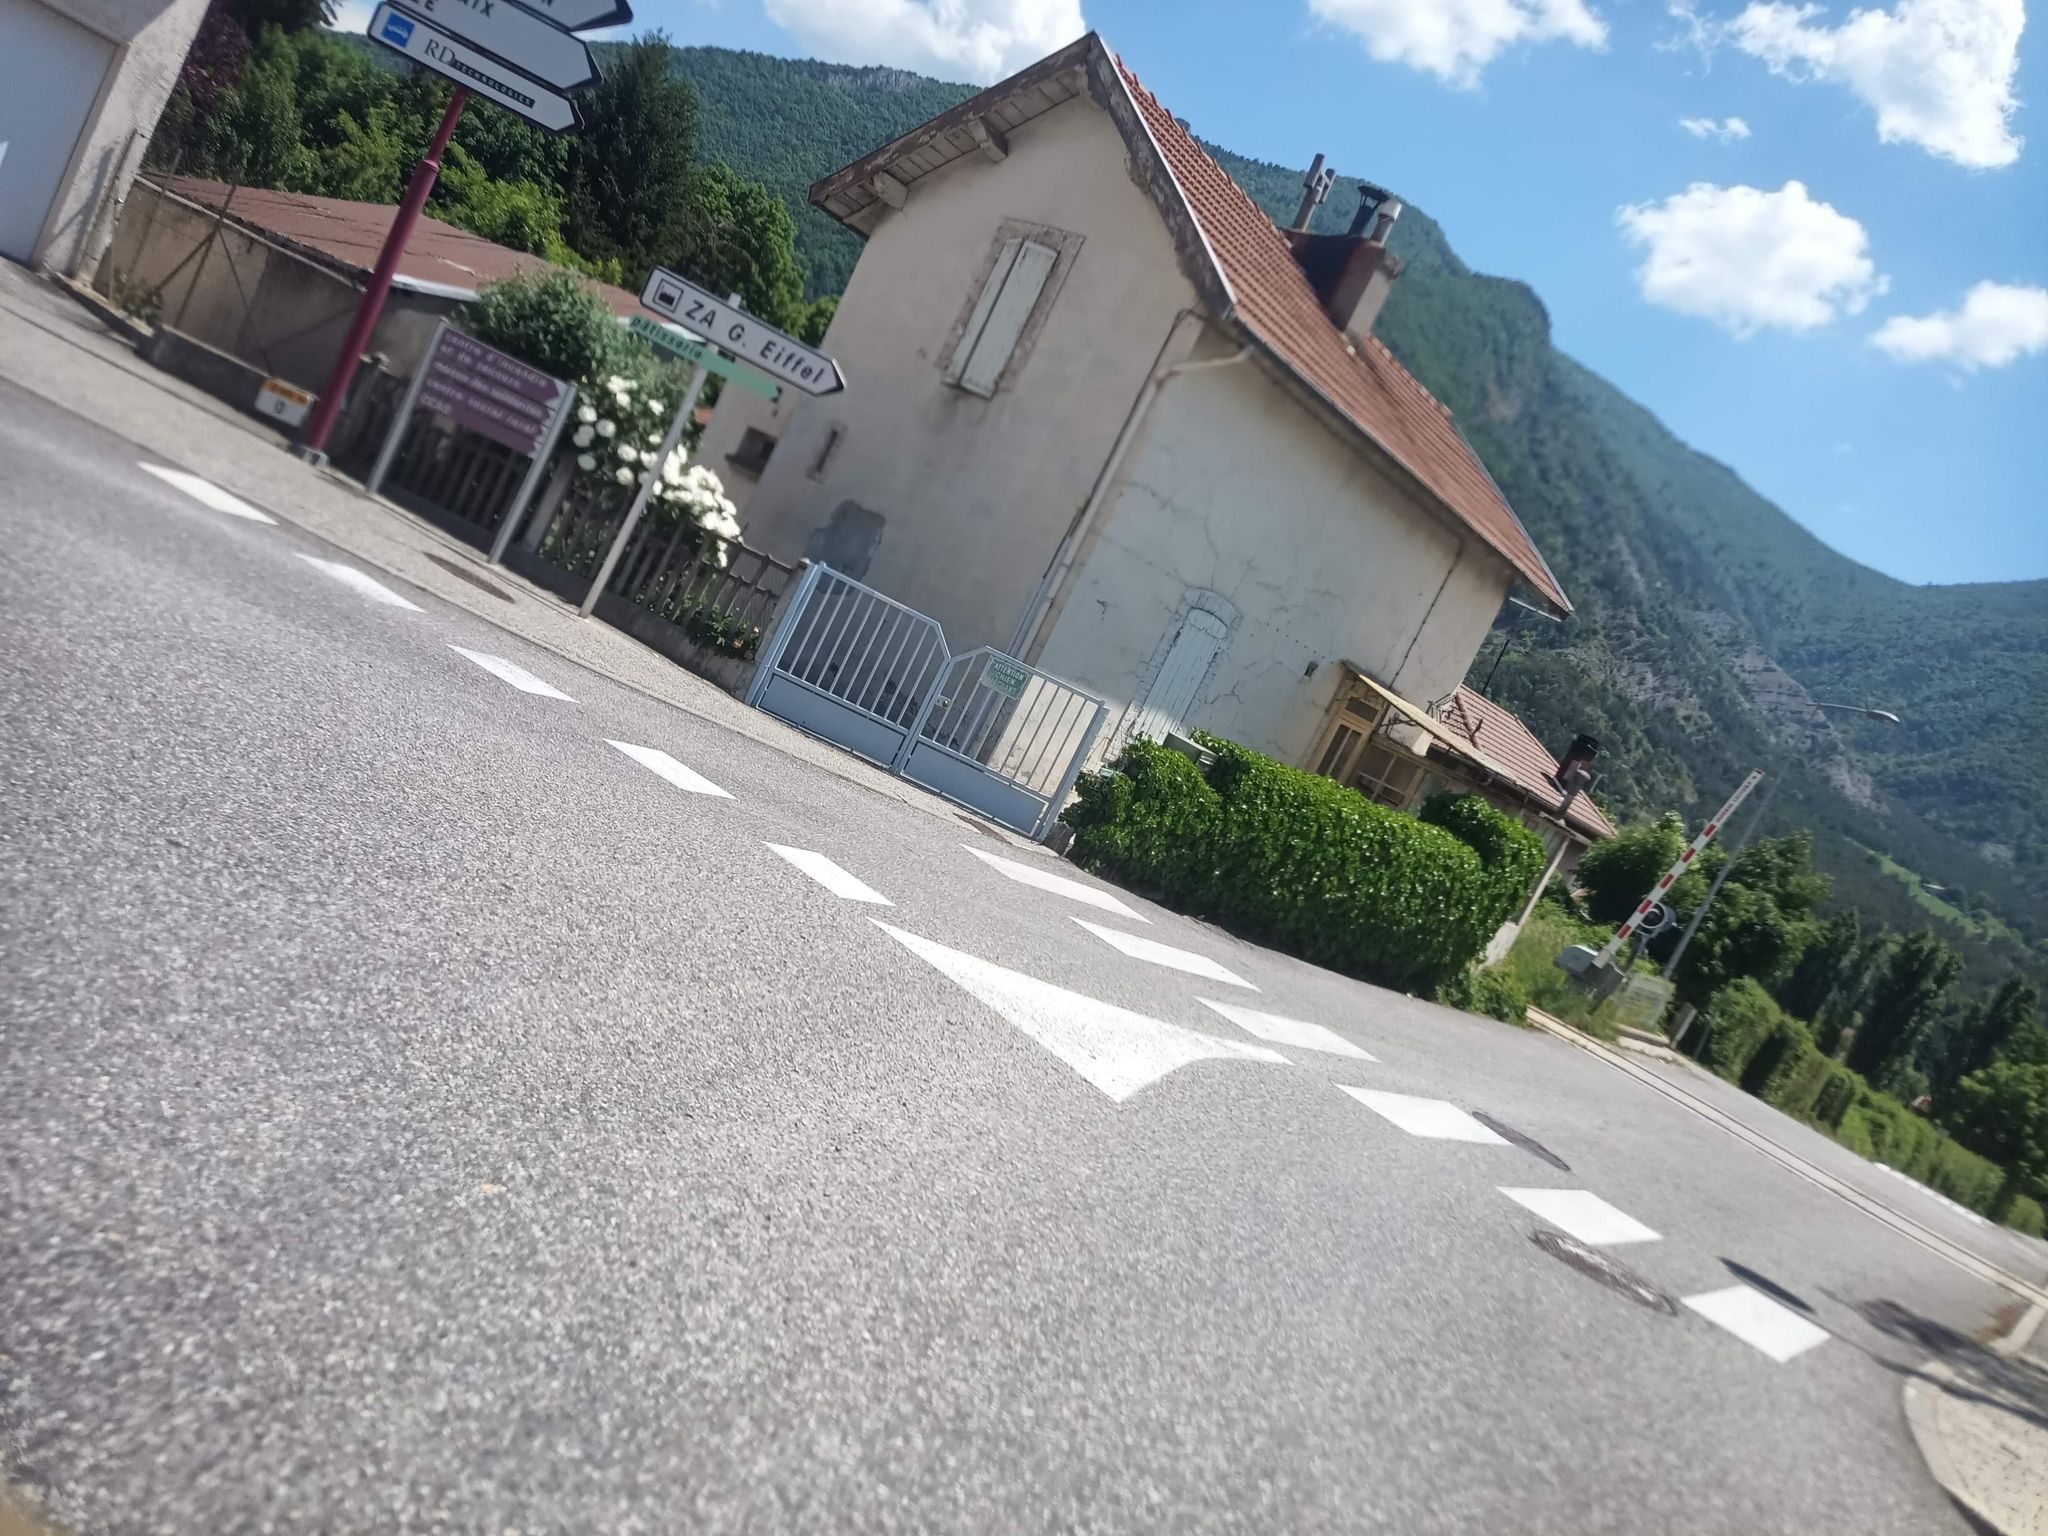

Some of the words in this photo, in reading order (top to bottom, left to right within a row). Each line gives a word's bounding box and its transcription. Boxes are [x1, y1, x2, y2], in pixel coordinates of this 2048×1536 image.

[455, 61, 534, 106] TECHNOLOGIES
[685, 301, 717, 328] ZA
[728, 323, 746, 347] G.
[760, 340, 825, 384] Eiffel
[993, 661, 1025, 682] ATTENTION
[995, 671, 1016, 686] CHIEN
